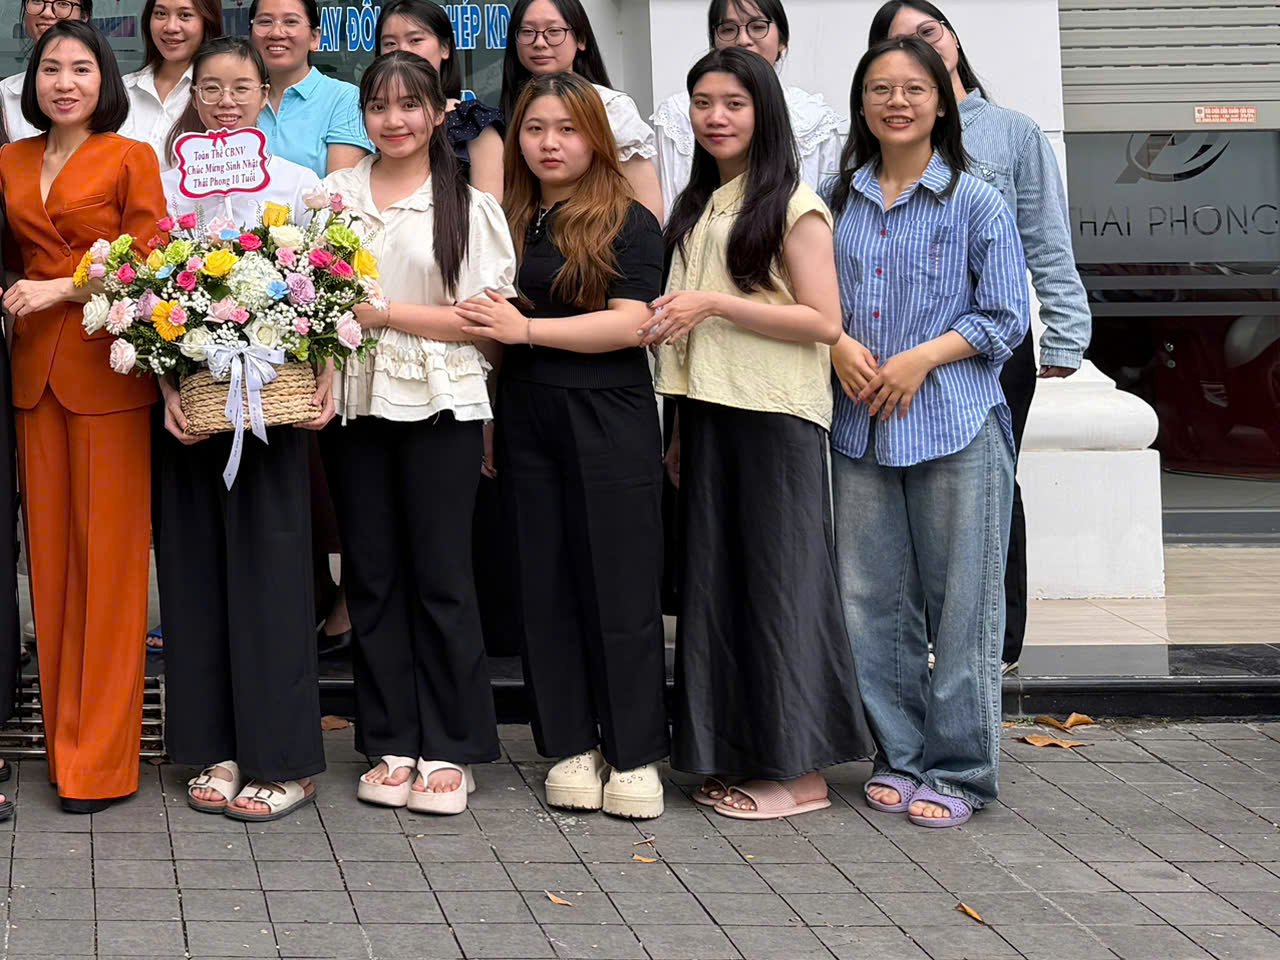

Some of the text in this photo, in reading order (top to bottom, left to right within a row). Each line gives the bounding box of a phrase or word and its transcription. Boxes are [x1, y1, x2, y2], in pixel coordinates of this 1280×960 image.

[187, 164, 204, 176] Chúc
[226, 161, 241, 172] Sinh
[243, 158, 258, 171] Nhật
[193, 178, 209, 189] Thái
[210, 176, 230, 187] Phong
[232, 174, 240, 184] 10
[1070, 203, 1279, 237] HAI PHONG
